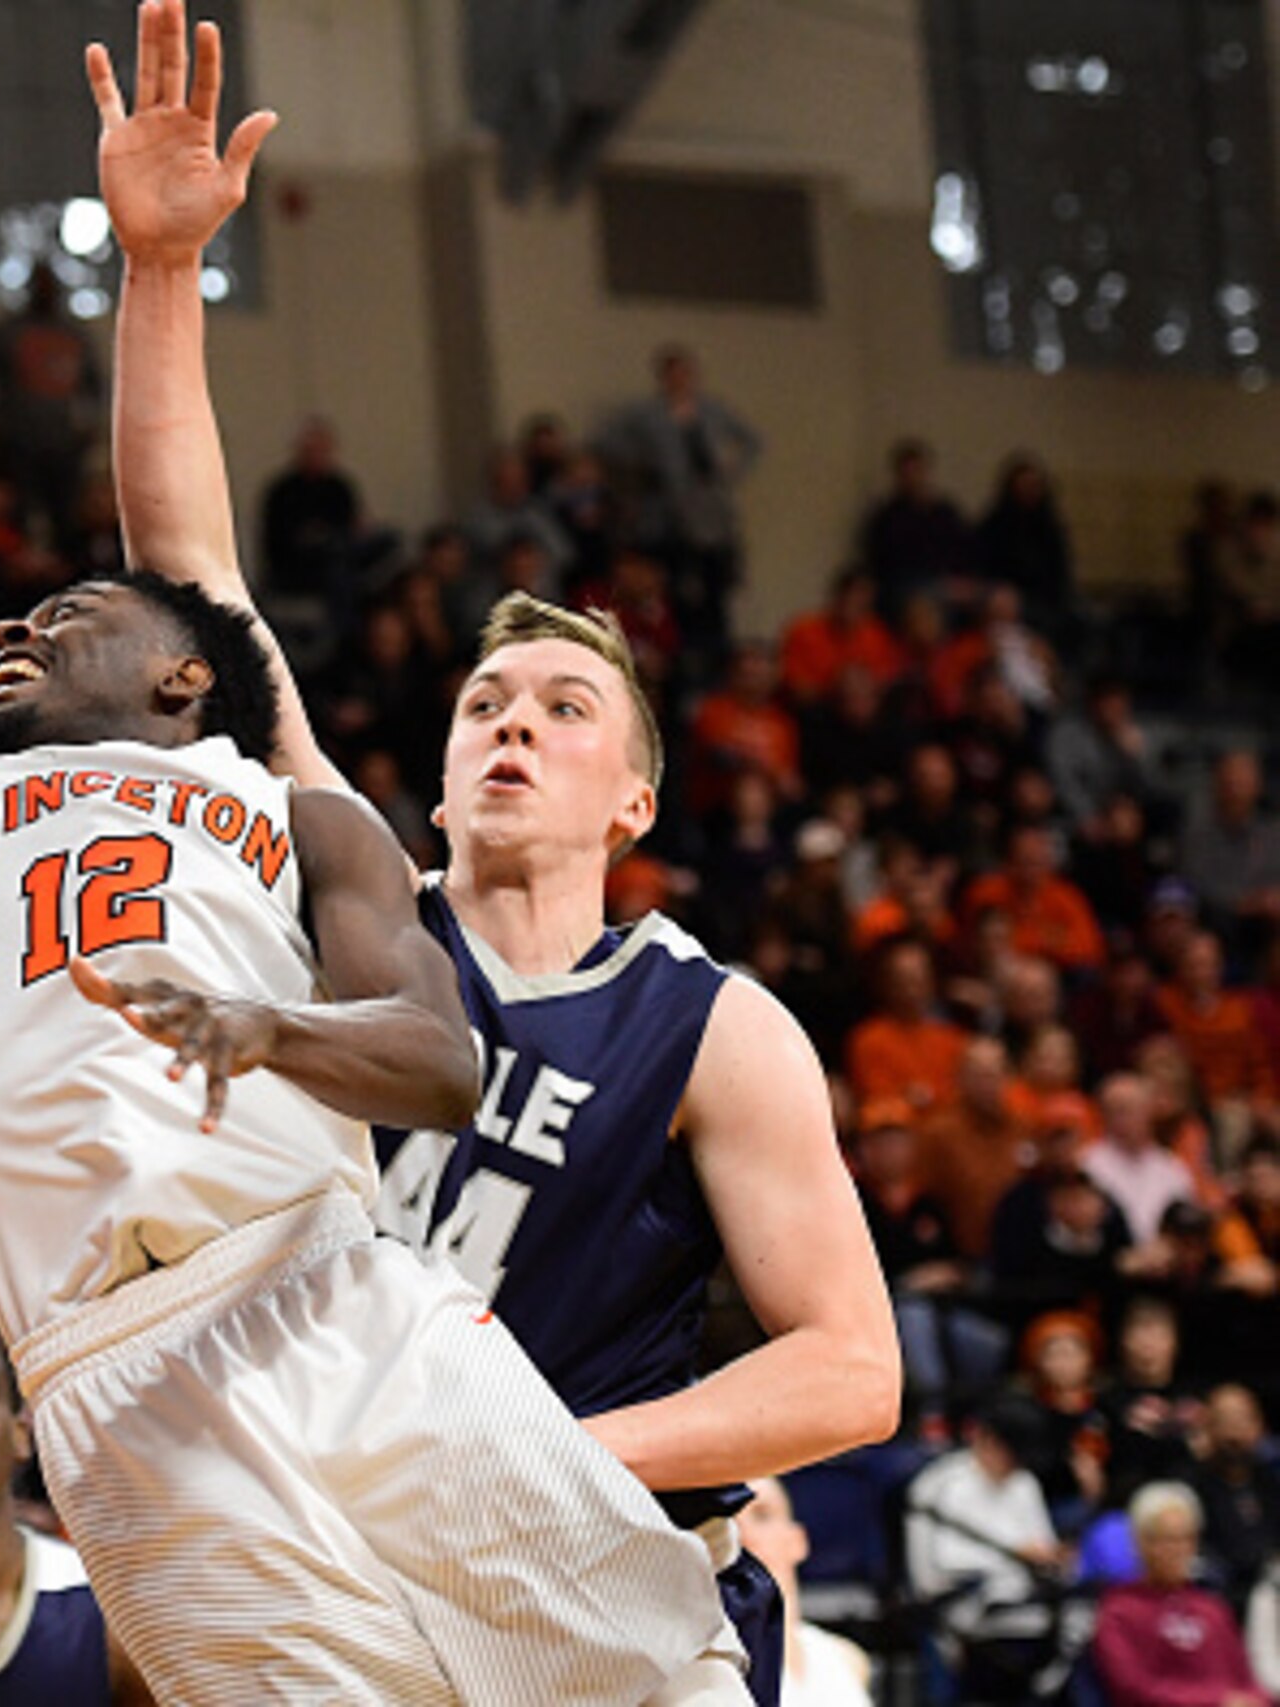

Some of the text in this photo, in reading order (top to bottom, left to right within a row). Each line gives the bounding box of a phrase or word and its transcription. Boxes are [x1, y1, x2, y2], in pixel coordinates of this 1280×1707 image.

[21, 832, 173, 988] 12
[475, 1046, 596, 1168] LE
[372, 1128, 535, 1304] 44
